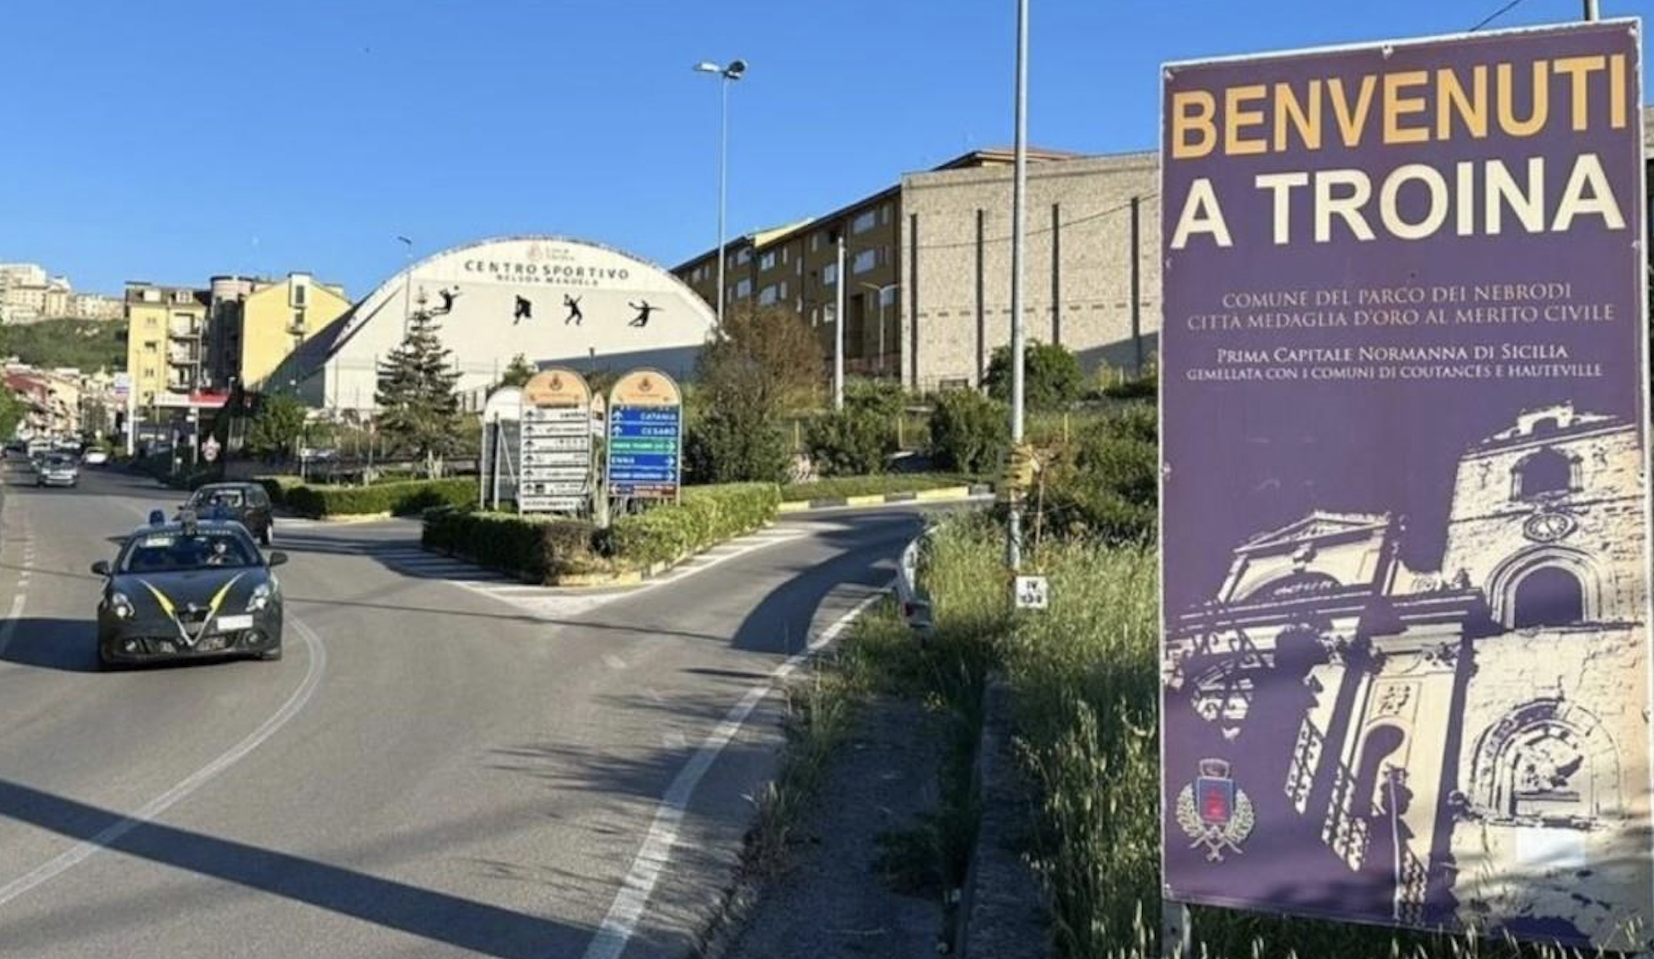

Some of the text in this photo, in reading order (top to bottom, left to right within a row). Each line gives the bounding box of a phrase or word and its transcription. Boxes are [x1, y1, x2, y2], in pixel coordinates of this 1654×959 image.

[1172, 54, 1626, 160] BENVENUTI
[1170, 154, 1626, 249] A TROINA
[464, 260, 629, 280] CENTRO SPORTIVO
[1223, 283, 1571, 308] COMUNE DEL PARCO DEI NEBRODI
[1247, 311, 1348, 329] MEDAGLIA
[1354, 309, 1419, 326] D'ORO
[1425, 309, 1448, 325] AL
[1455, 306, 1538, 324] MERITO
[1544, 303, 1615, 322] CIVILE
[1217, 342, 1568, 364] PRIMA CAPITALE NORMANNA DI SICILIA
[1186, 363, 1603, 381] GEMELLATA CON I COMUNI DI COUTANCES E HAUTEVILLE
[641, 411, 676, 421] CATANIA
[611, 456, 635, 465] ENNA
